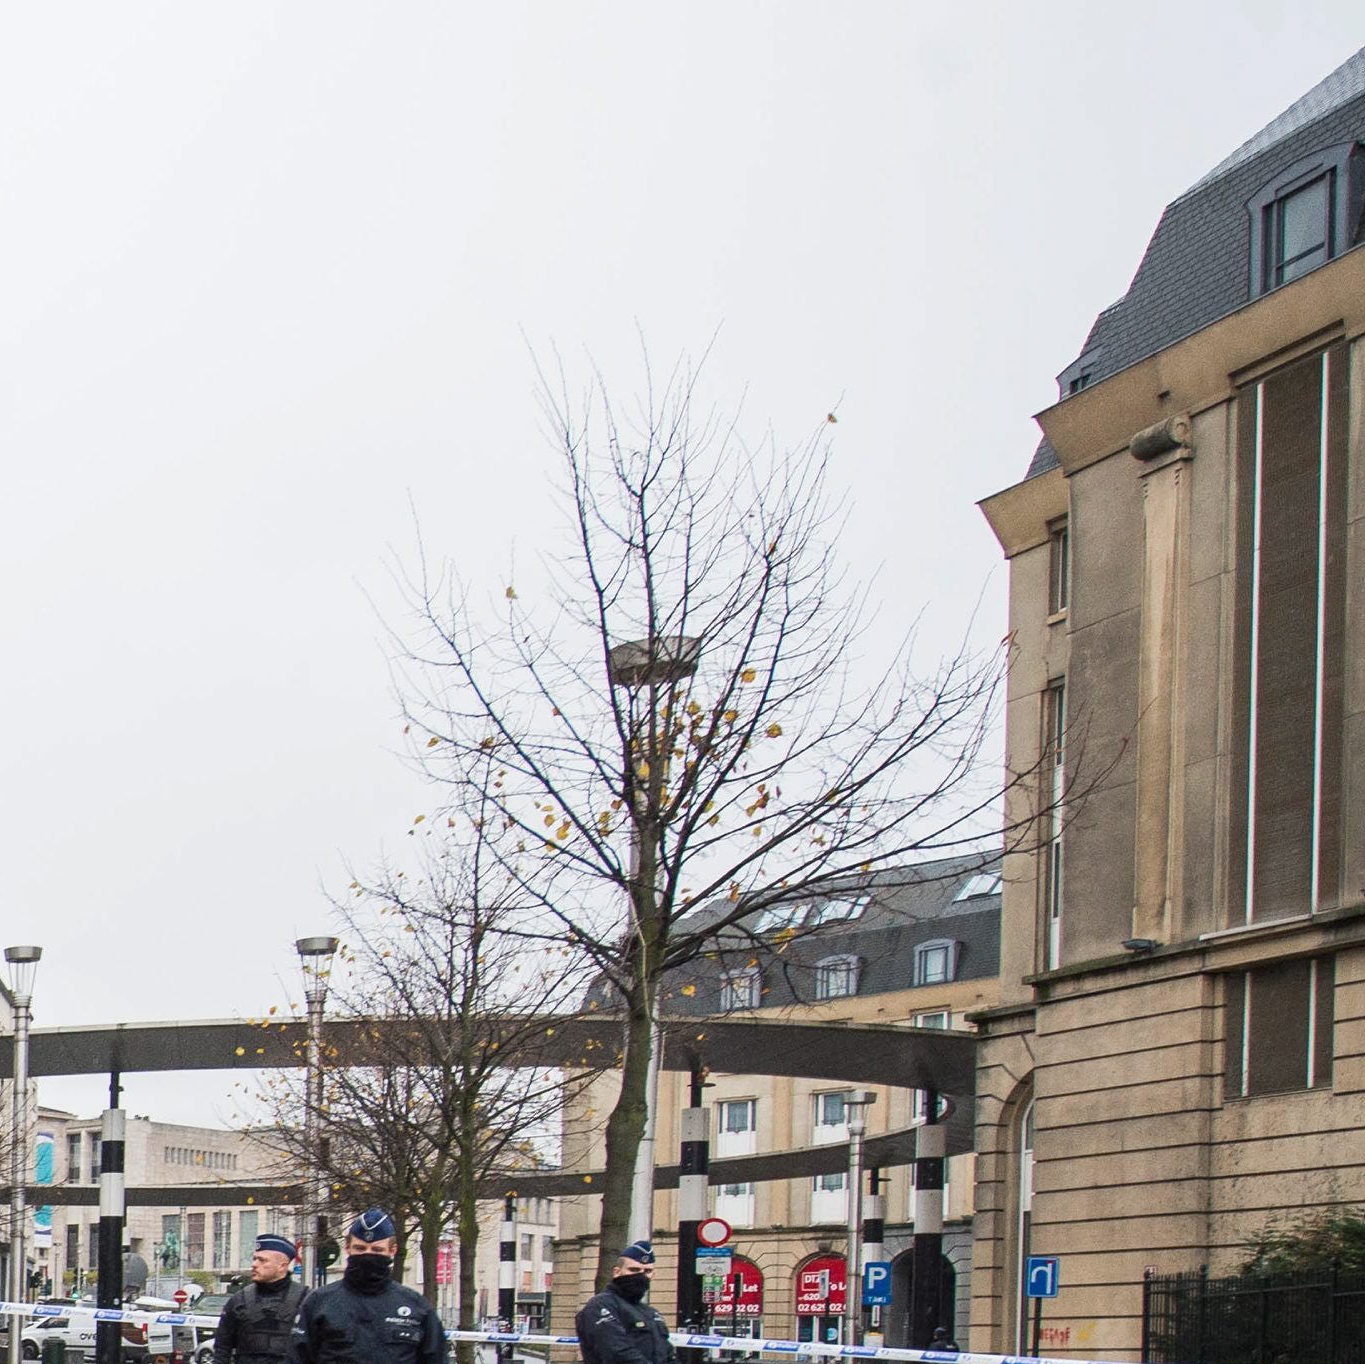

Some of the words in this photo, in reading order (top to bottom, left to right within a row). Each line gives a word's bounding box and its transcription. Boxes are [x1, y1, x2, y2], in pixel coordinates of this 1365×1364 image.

[868, 1267, 887, 1289] P
[743, 1284, 758, 1292] Let
[715, 1304, 733, 1312] 629
[830, 1303, 842, 1311] 02
